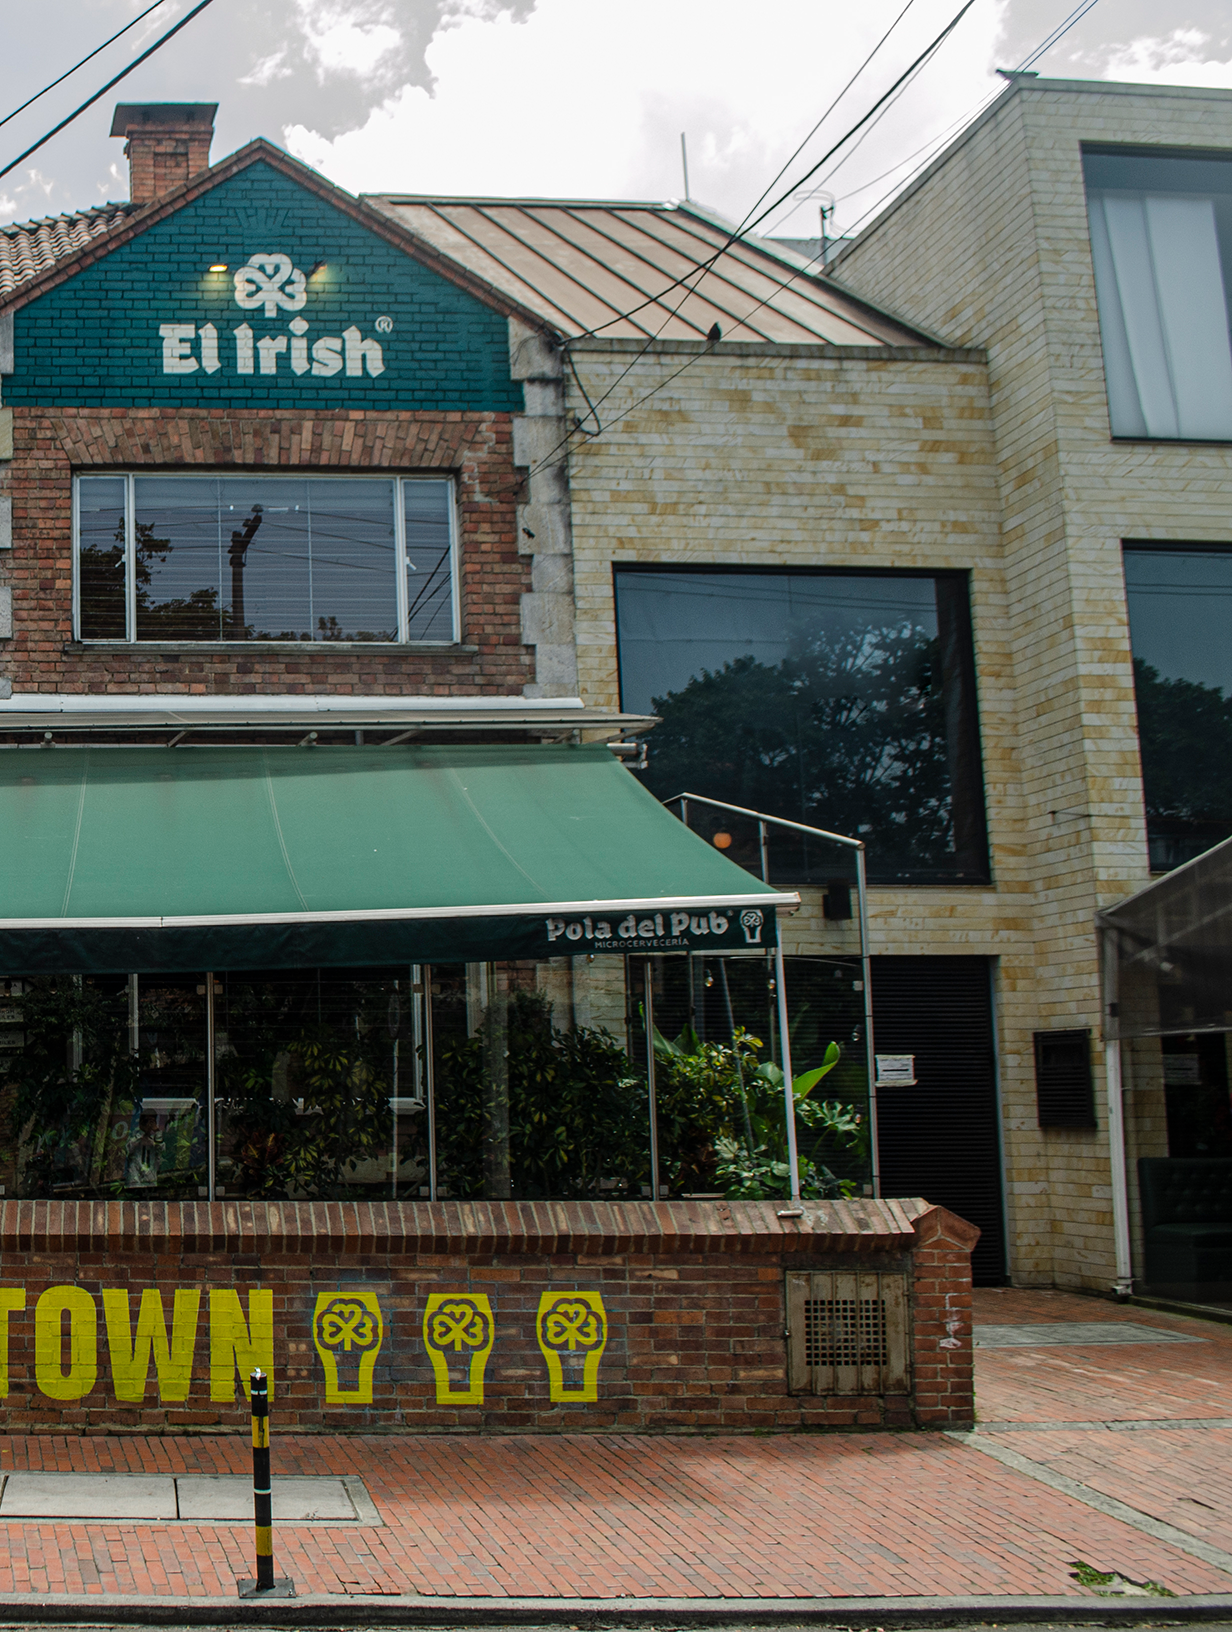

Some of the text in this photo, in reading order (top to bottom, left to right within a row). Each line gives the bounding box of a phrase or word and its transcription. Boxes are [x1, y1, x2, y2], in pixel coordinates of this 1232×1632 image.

[159, 316, 386, 378] El Irish
[545, 911, 729, 941] Pola del Pub
[594, 937, 690, 949] MICROCERVECERÍA
